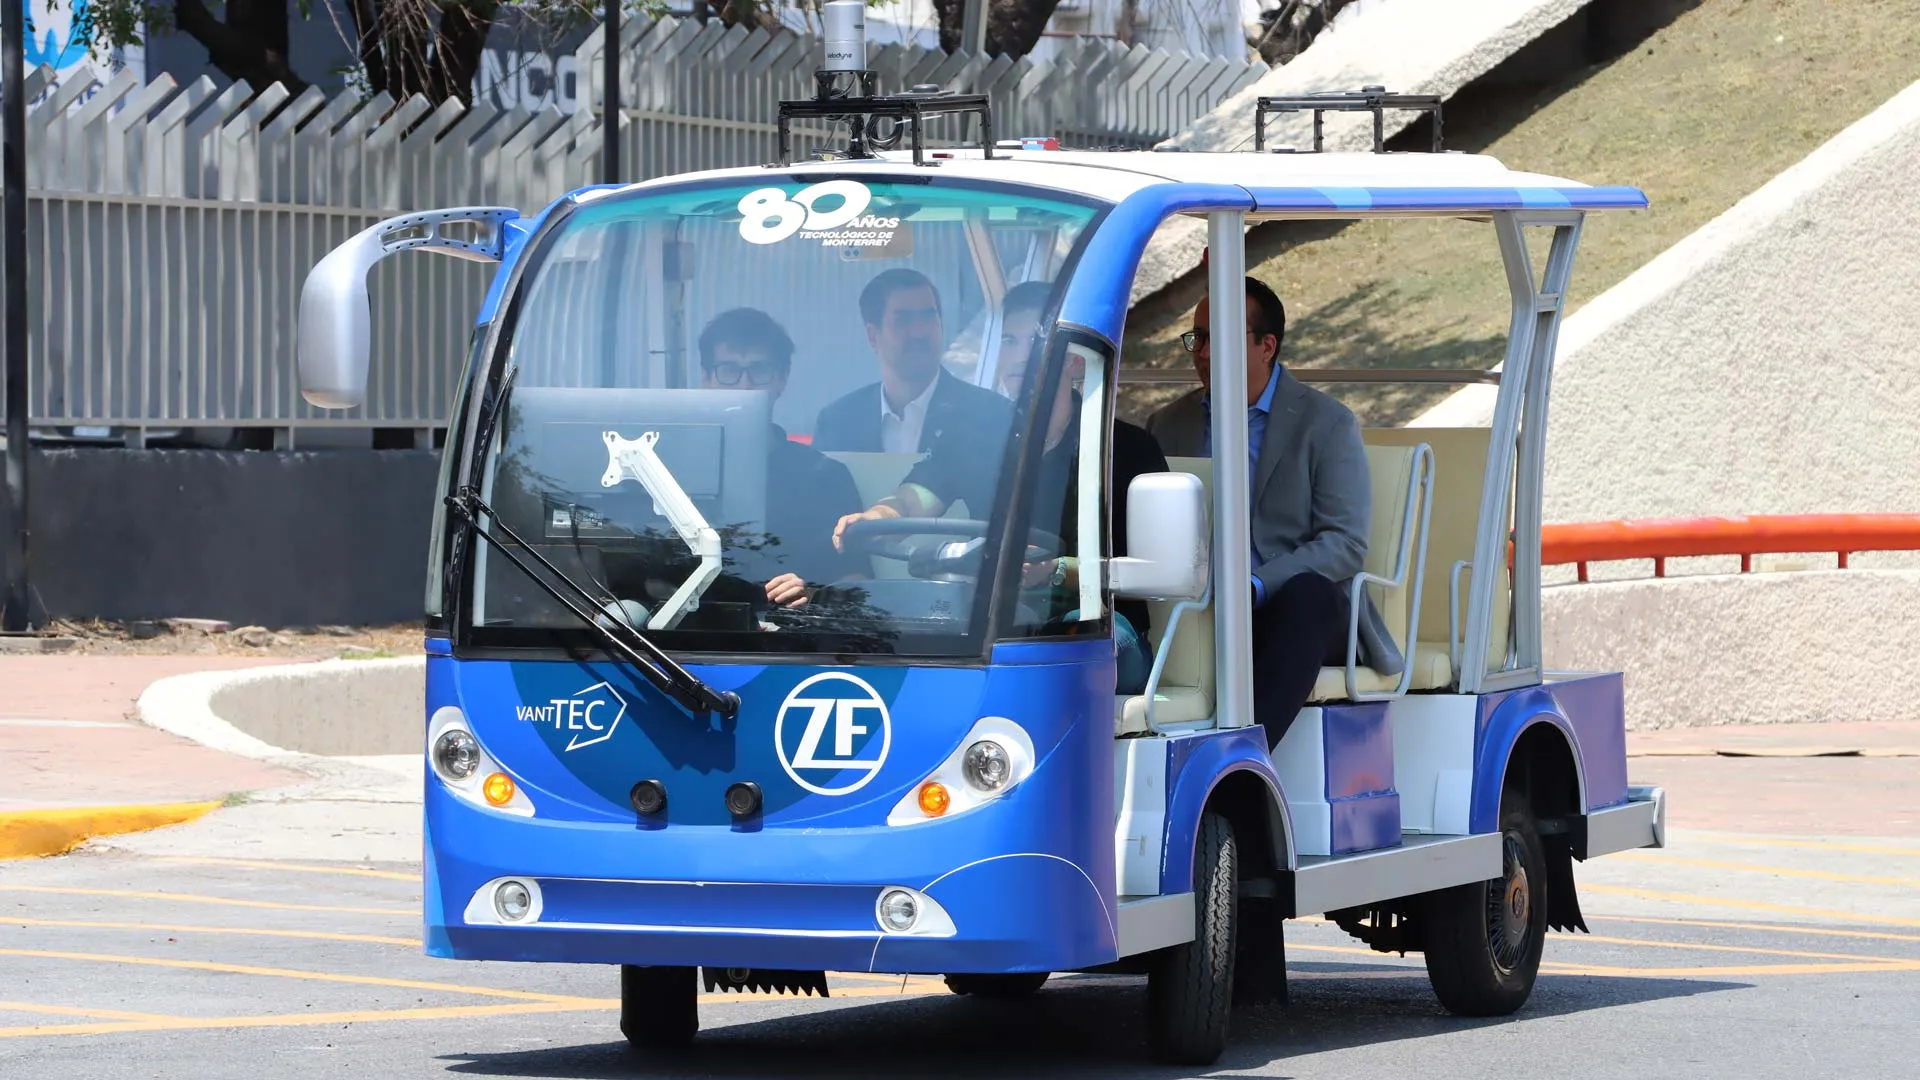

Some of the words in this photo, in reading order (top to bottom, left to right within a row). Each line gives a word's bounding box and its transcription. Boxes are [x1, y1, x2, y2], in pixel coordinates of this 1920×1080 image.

[737, 179, 872, 245] 80
[846, 214, 900, 229] AÑOS
[799, 230, 876, 239] TECNOLÓGICO
[878, 231, 894, 239] DE
[822, 238, 891, 247] MONTERREY
[782, 696, 884, 770] ZF
